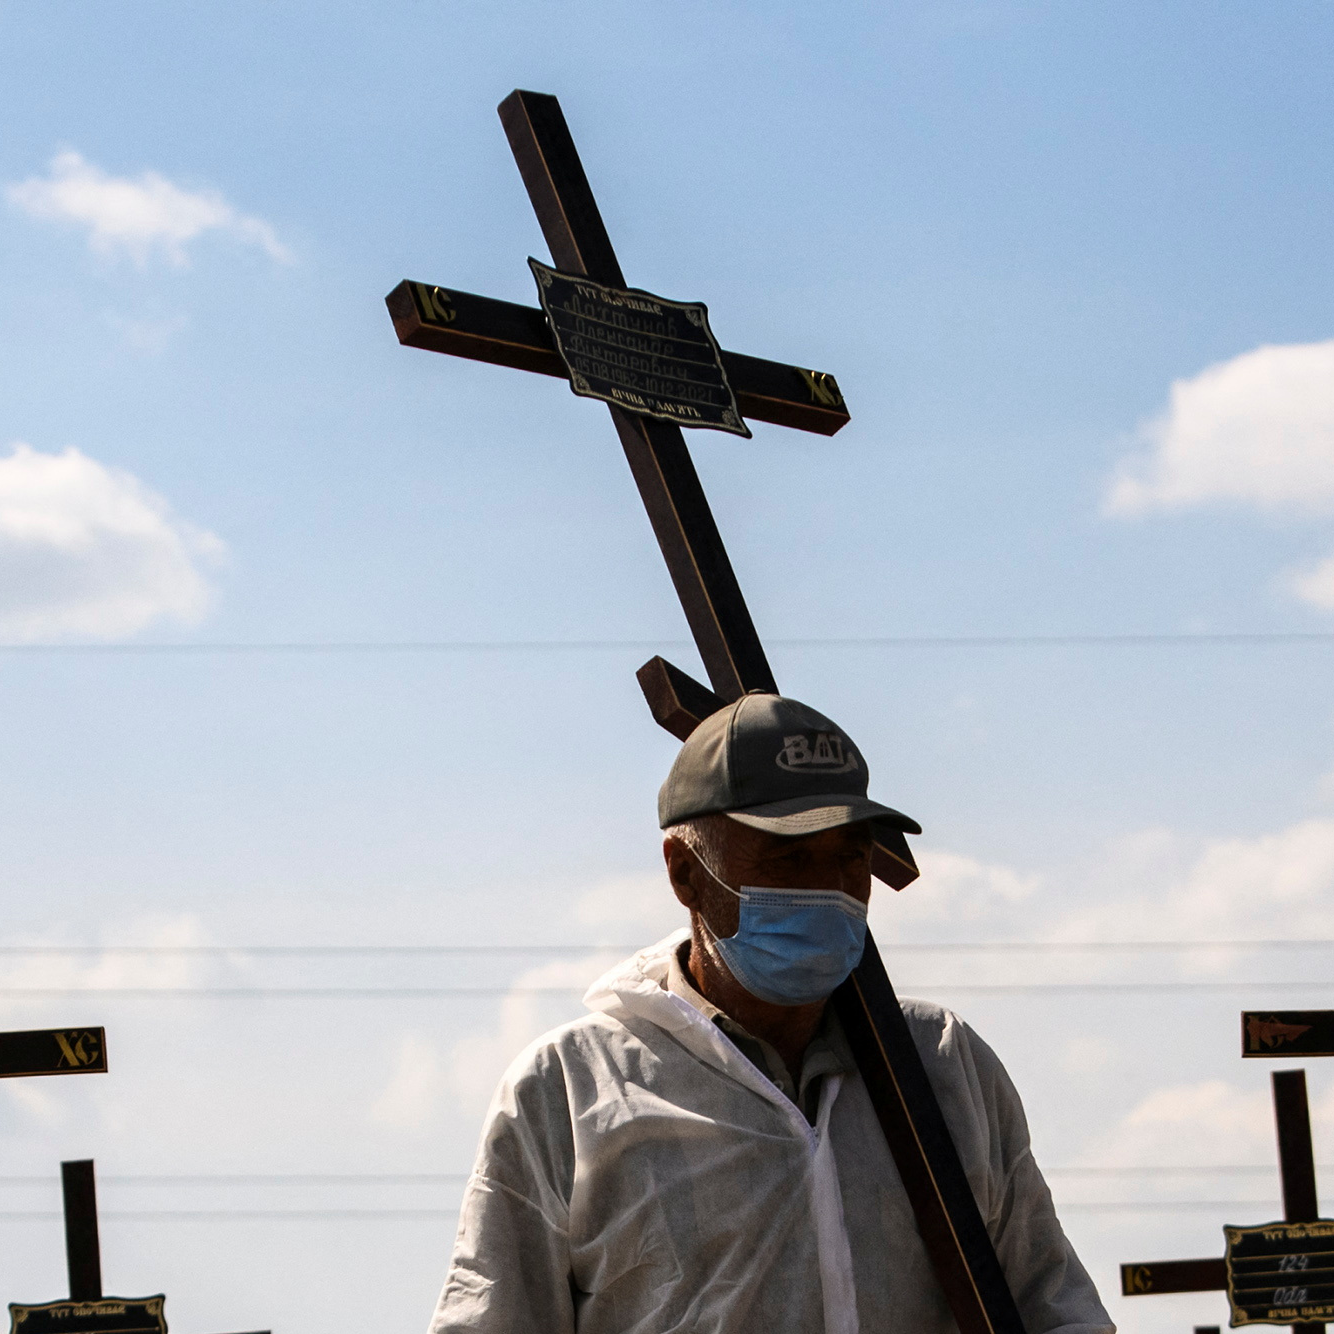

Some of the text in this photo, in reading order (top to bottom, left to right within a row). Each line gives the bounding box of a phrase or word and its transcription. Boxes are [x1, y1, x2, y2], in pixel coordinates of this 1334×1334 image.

[575, 284, 597, 300] ТУТ
[611, 388, 645, 406] ВІЧНА
[1279, 1254, 1309, 1272] 124
